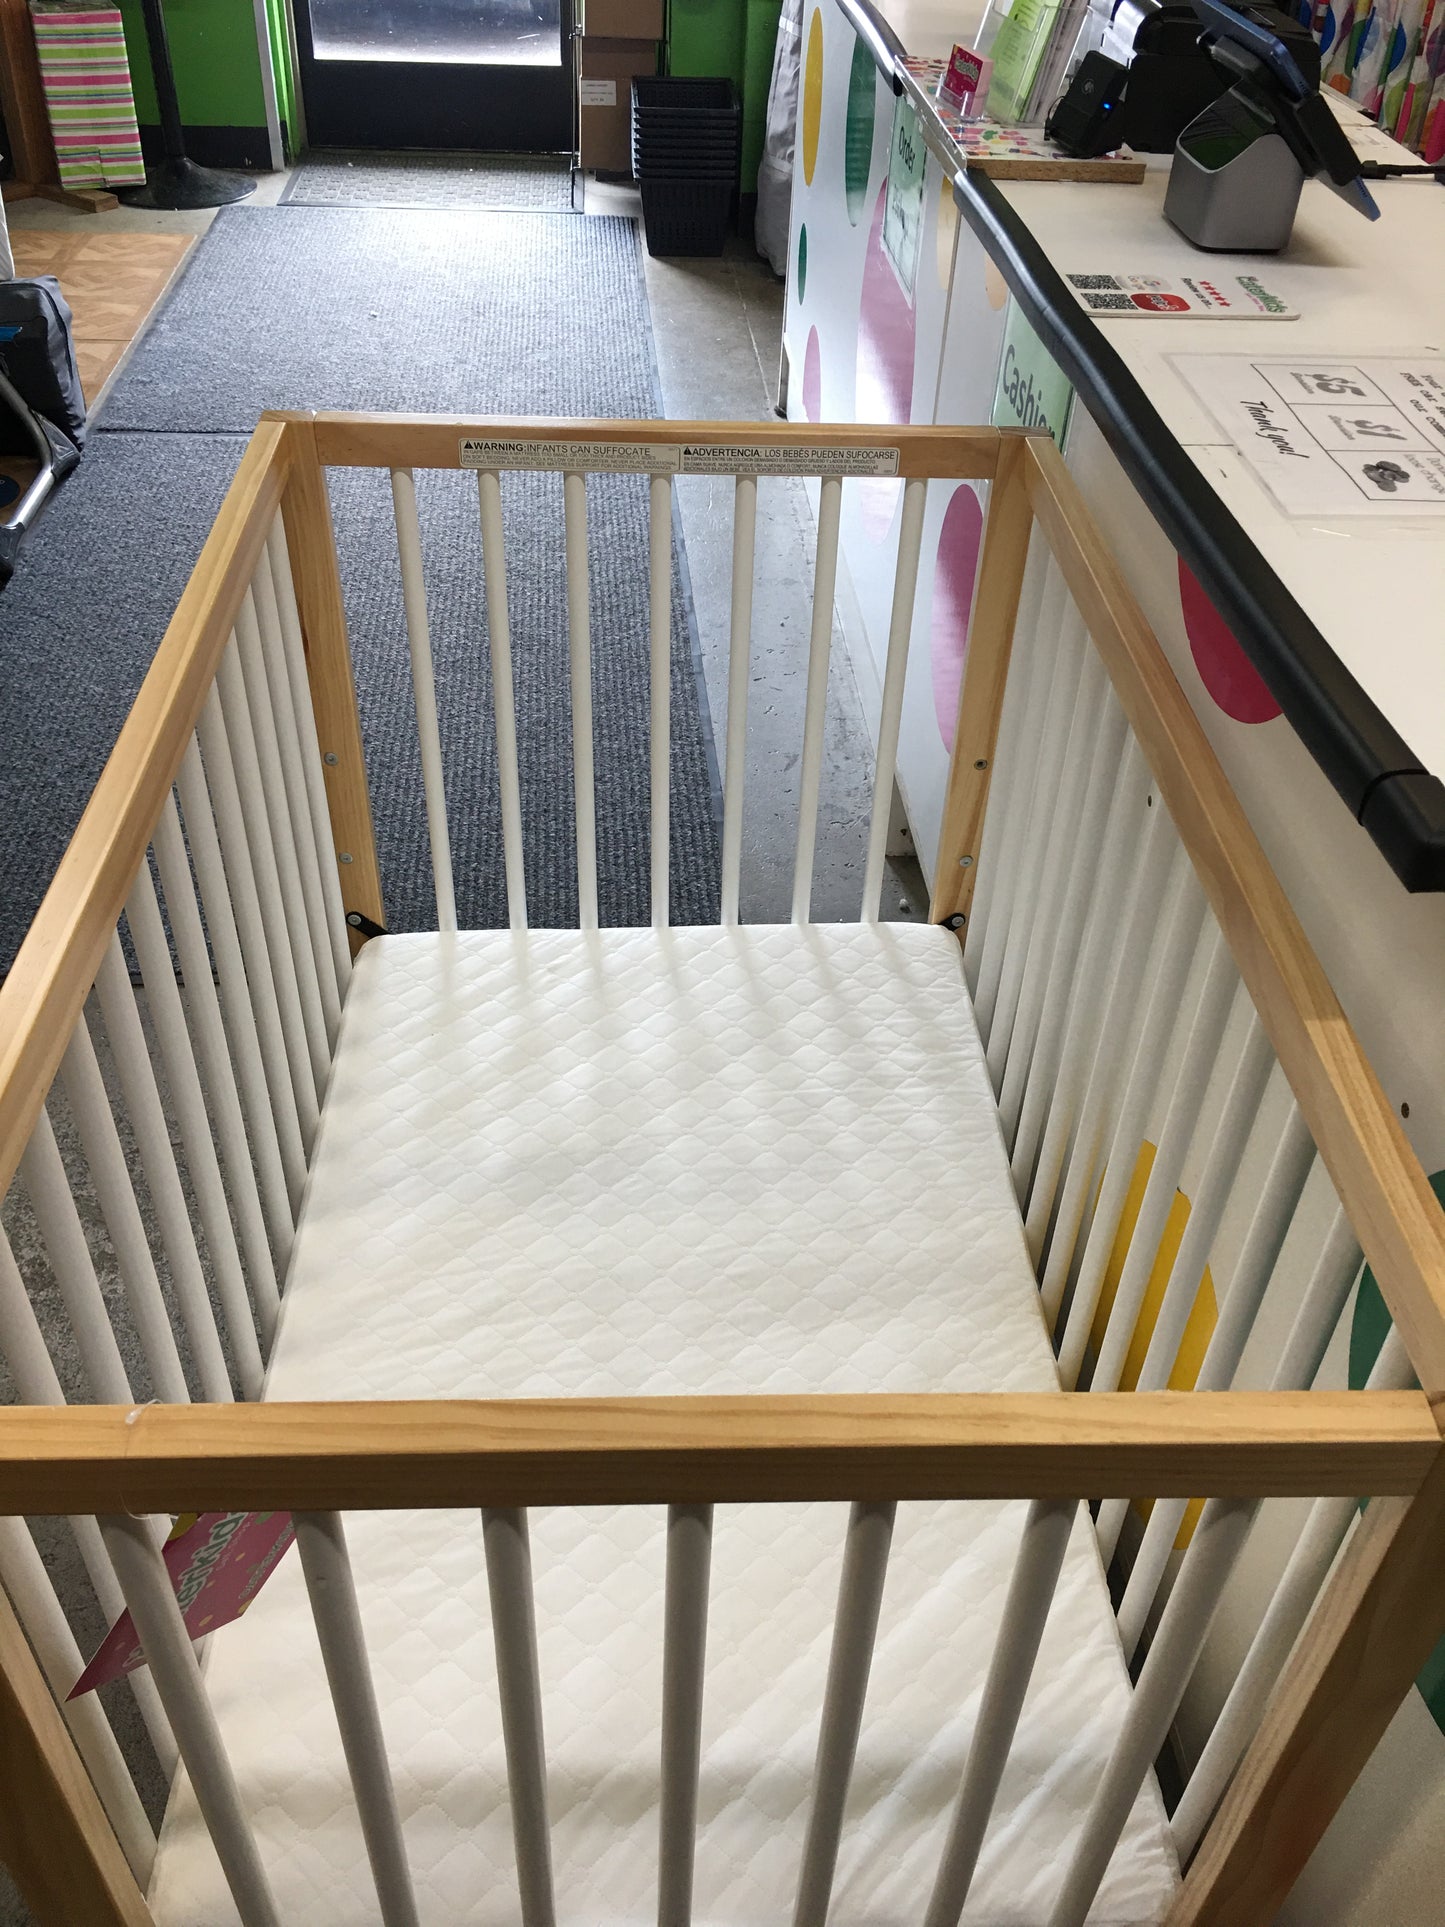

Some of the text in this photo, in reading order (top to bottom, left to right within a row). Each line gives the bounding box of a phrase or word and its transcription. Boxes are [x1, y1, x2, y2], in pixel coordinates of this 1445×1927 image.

[898, 126, 916, 174] Order
[1004, 344, 1055, 439] Cashi
[1304, 373, 1367, 397] $5
[1409, 400, 1428, 413] our
[1240, 400, 1310, 459] Thank you!
[1345, 419, 1408, 441] $1
[474, 442, 652, 456] WARNING: INFANTS CAN SUFFOCATE
[692, 448, 895, 460] ADVERTENCIA: LOS BEBÉS PUEDEN SUFOCARSE
